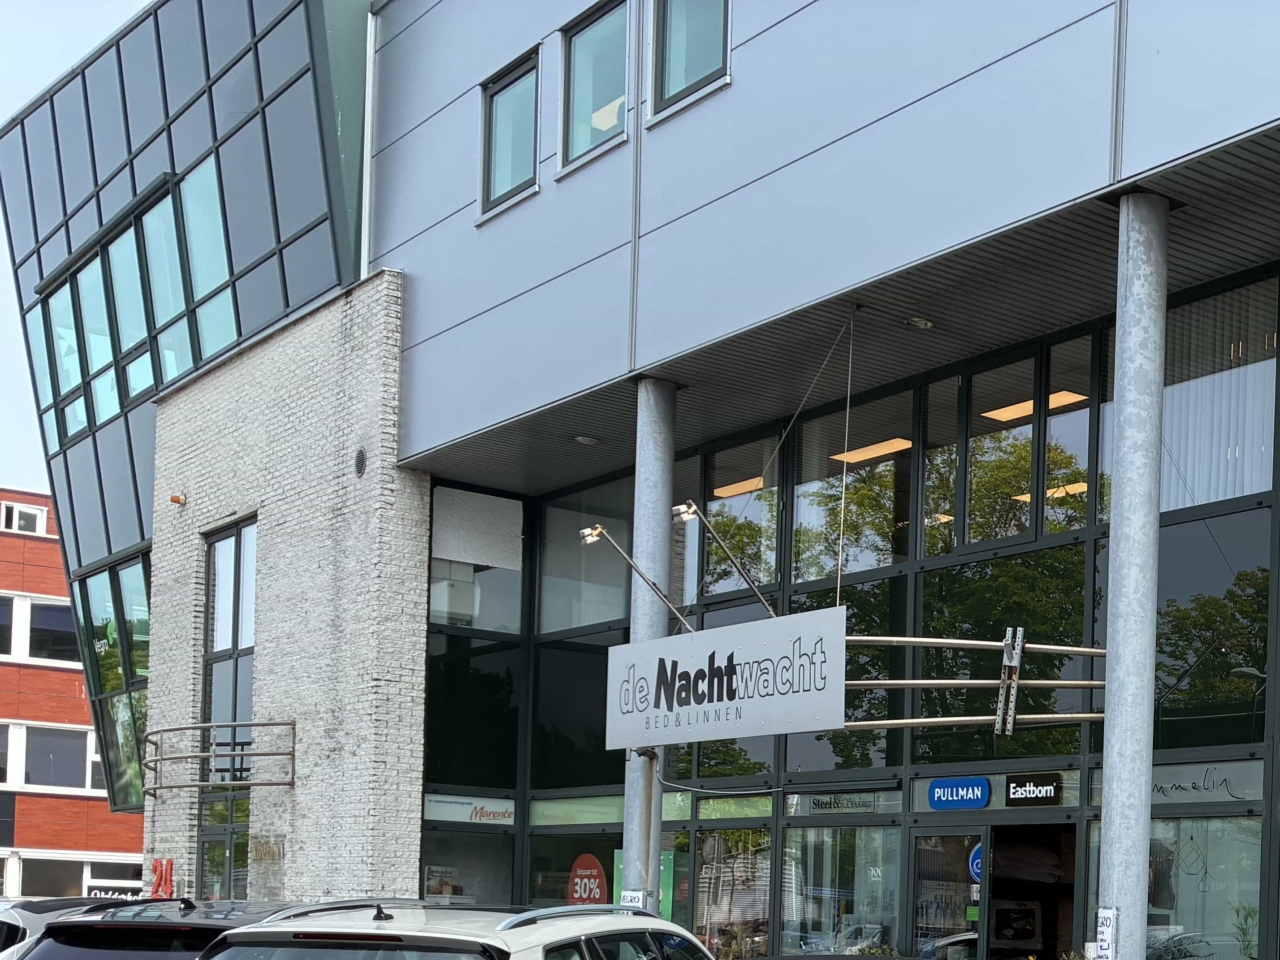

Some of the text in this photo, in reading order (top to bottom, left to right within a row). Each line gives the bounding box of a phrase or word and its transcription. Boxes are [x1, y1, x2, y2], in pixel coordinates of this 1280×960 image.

[619, 636, 827, 714] de Nachtwacht
[1009, 783, 1055, 799] Eastborn
[1152, 767, 1245, 799] mmelin
[934, 786, 982, 800] PULLMAN
[811, 797, 832, 809] Steel
[469, 805, 514, 821] Marente
[152, 858, 173, 899] 24
[573, 877, 601, 899] 30%
